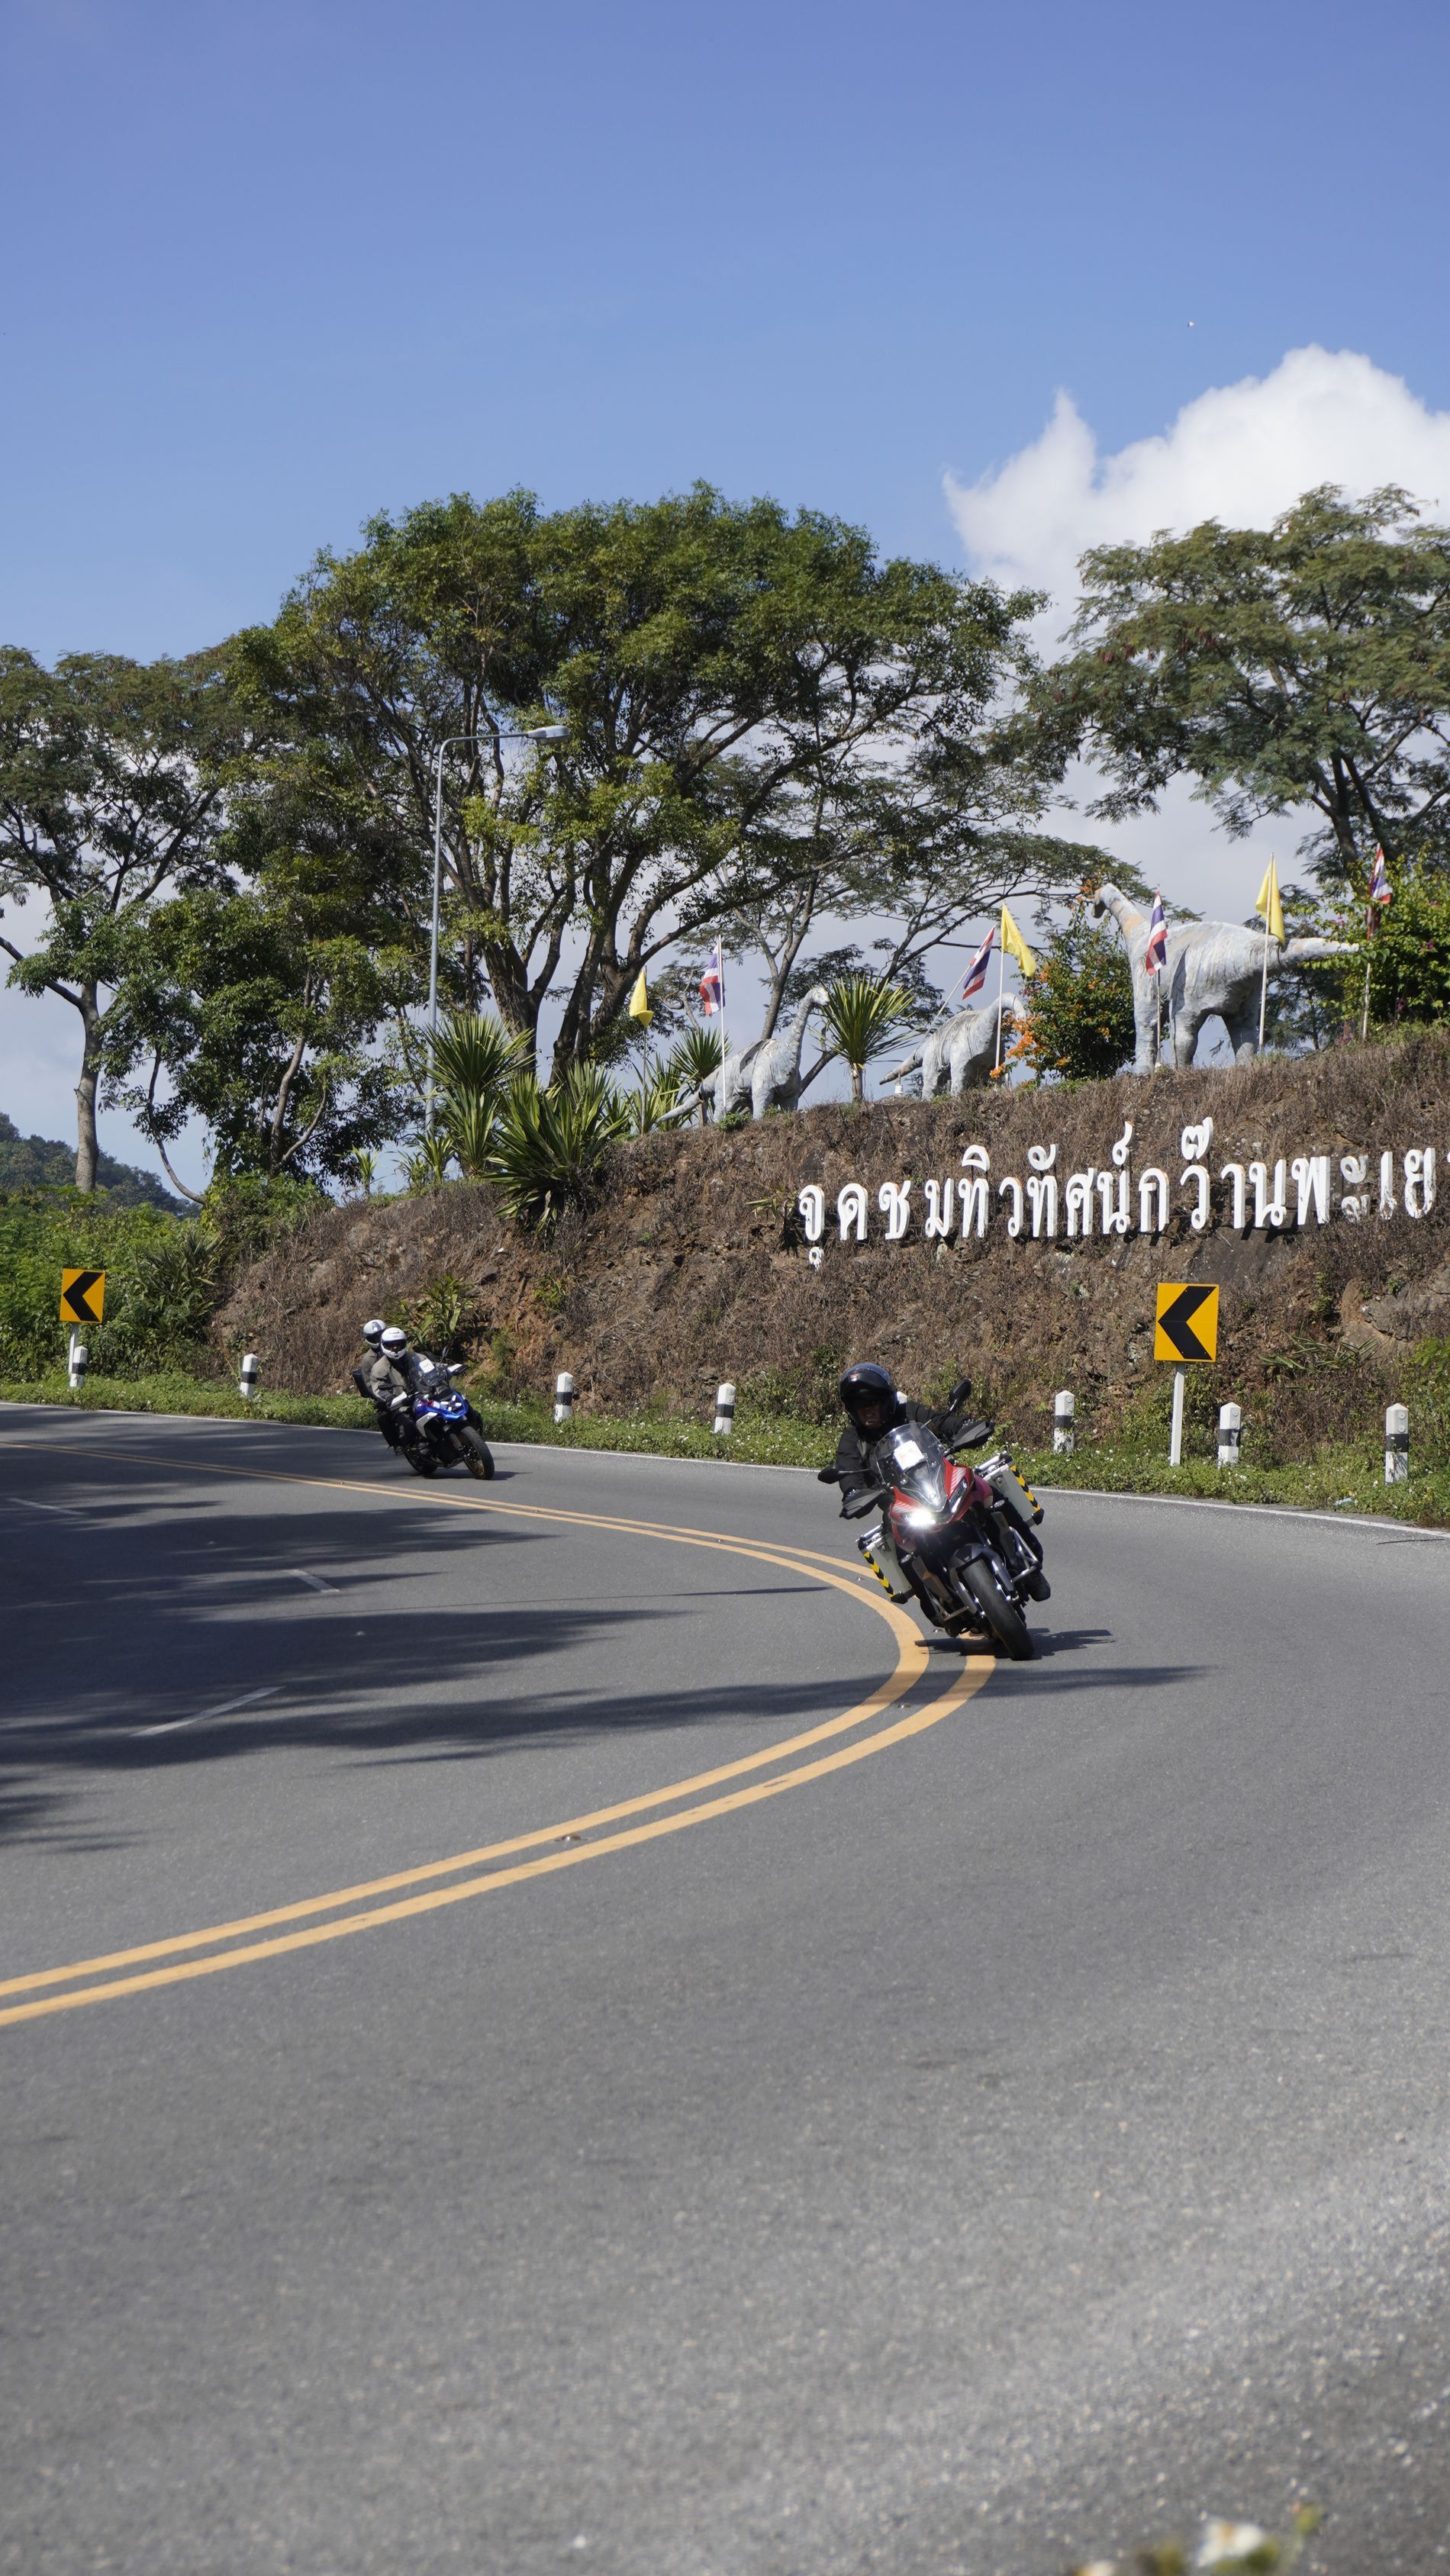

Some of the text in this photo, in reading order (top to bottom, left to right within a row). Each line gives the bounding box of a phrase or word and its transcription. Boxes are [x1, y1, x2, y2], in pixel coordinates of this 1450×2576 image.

[798, 1116, 1450, 1271] จุดชมทิวทัศน์กว๊านพะเย
